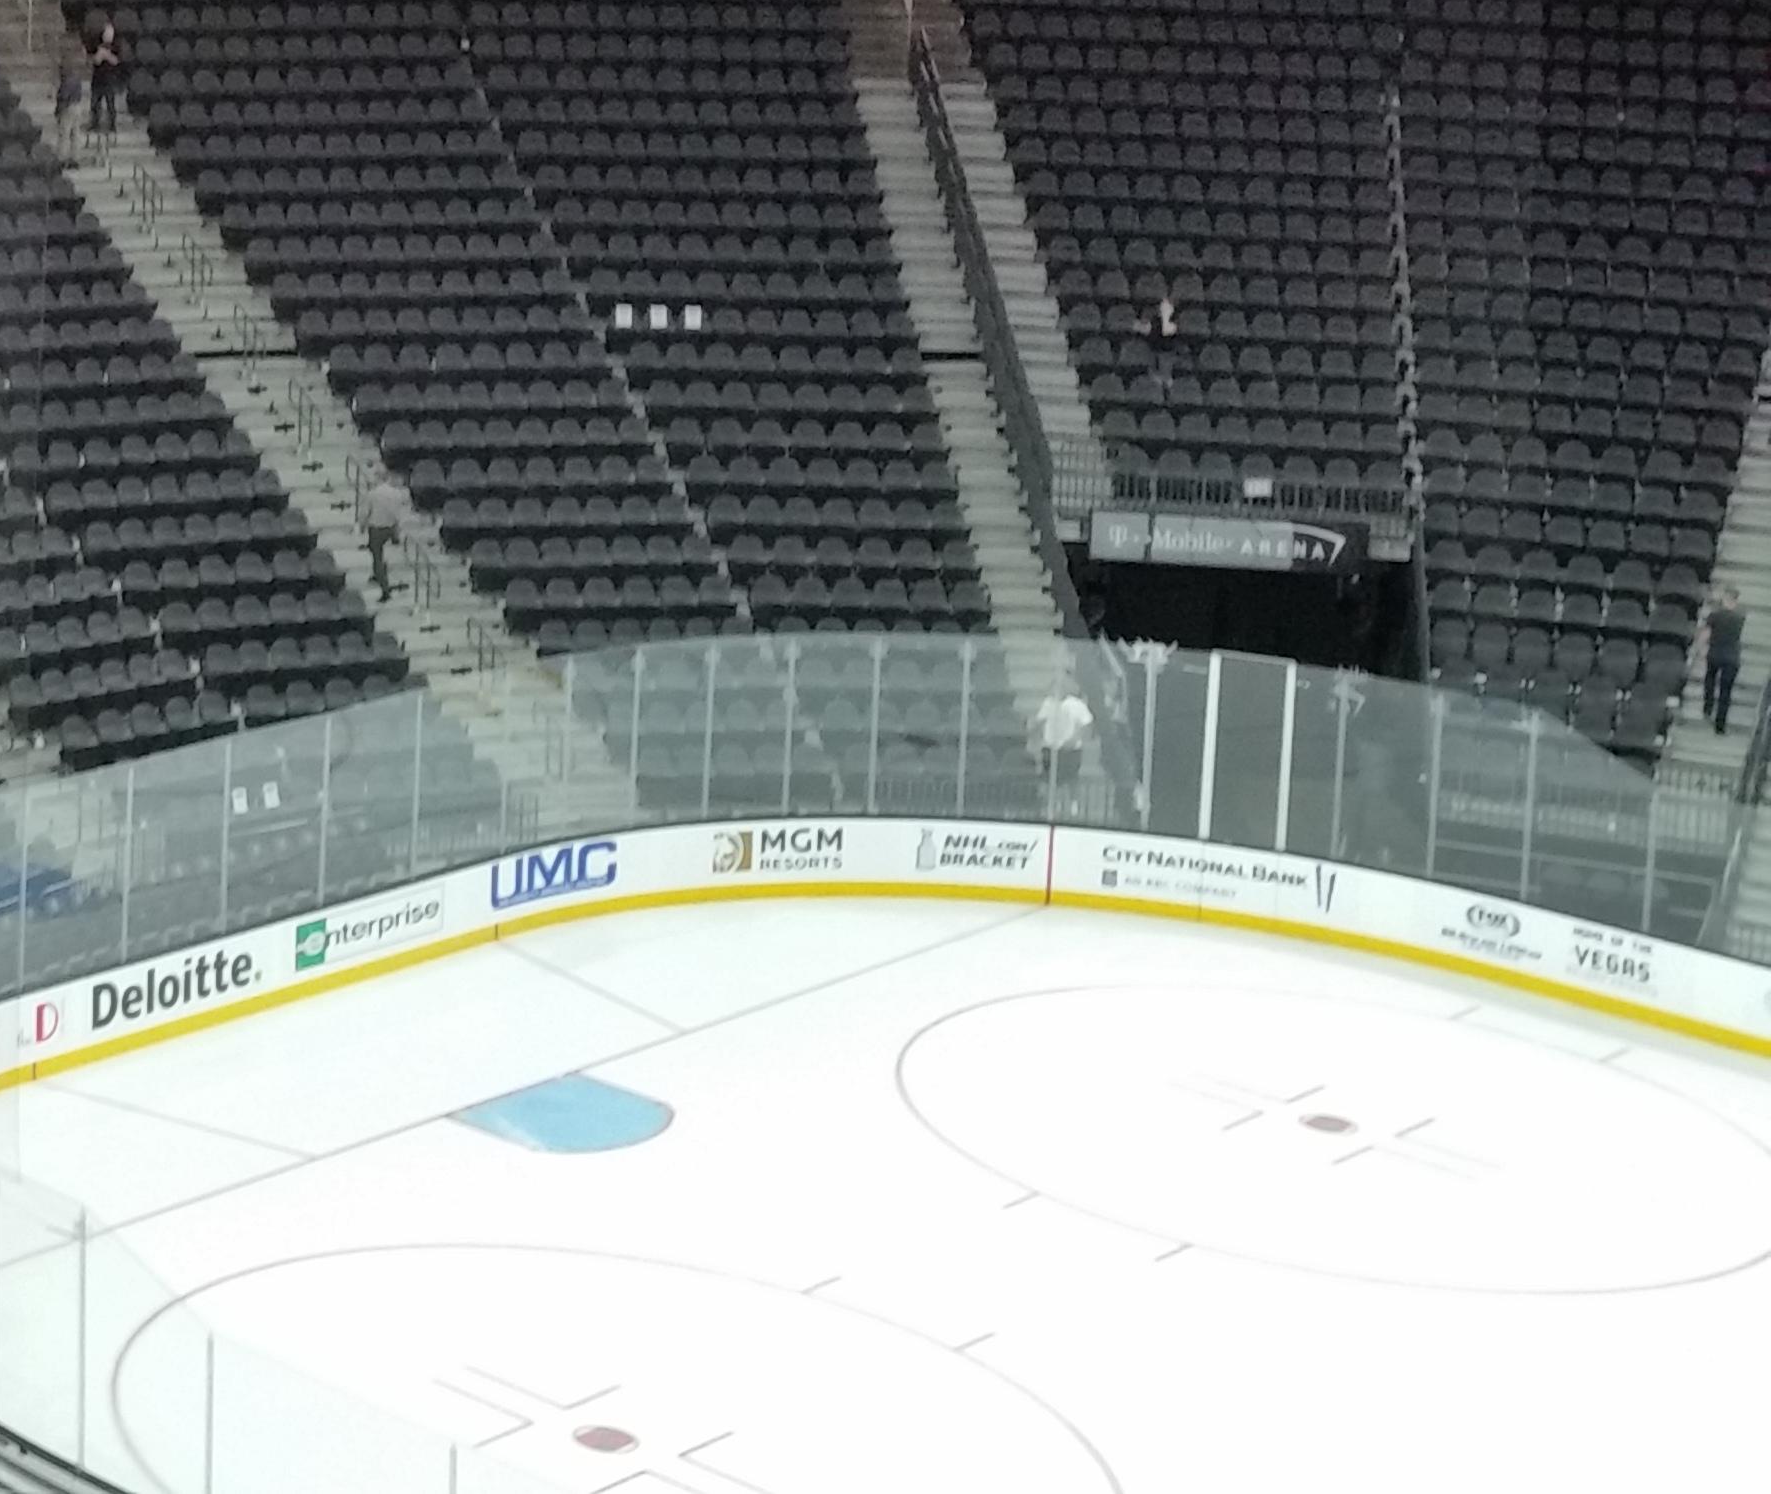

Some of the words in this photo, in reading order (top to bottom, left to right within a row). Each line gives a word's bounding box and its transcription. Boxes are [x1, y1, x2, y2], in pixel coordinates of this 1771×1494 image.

[1240, 537, 1326, 561] ARENA
[760, 827, 845, 853] MGM
[759, 856, 844, 871] RESORTS
[939, 852, 1030, 870] BRACKET
[491, 841, 618, 910] UMC
[1574, 944, 1651, 983] VEGAS
[35, 1003, 60, 1044] D
